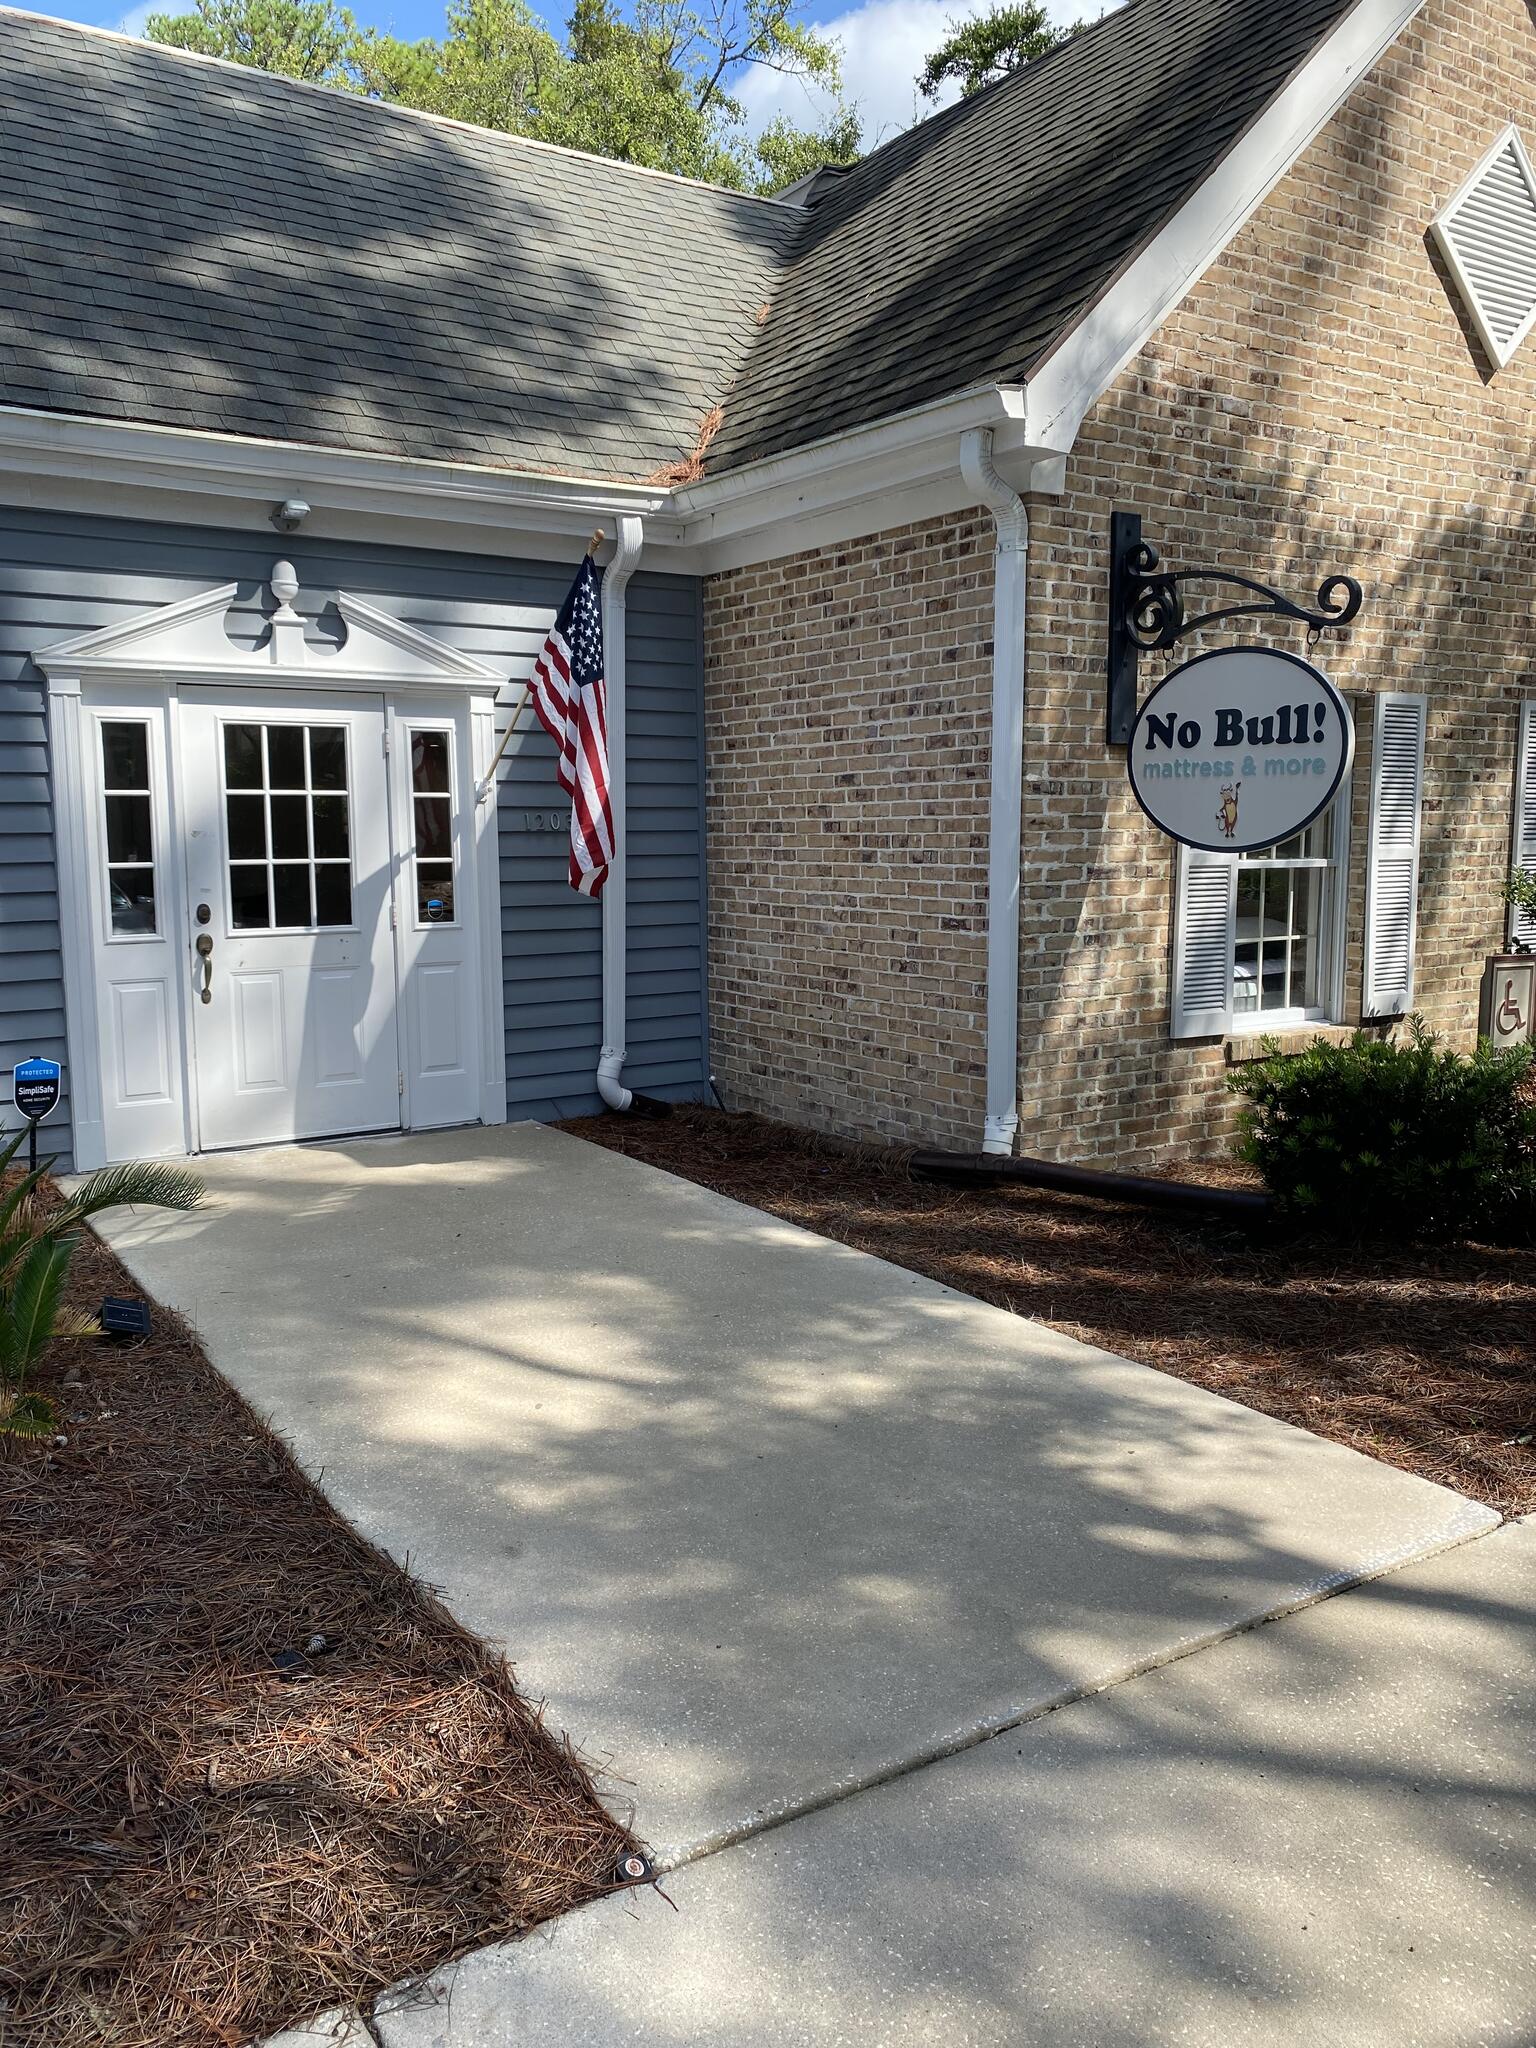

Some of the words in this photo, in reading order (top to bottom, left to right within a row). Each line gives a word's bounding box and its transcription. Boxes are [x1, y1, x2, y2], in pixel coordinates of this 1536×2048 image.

[1145, 712, 1201, 749] No
[1214, 702, 1326, 747] Bull!
[1143, 757, 1234, 779] mattress
[1241, 755, 1256, 777] &
[1264, 757, 1326, 776] more
[18, 1085, 54, 1096] SimpliSafe
